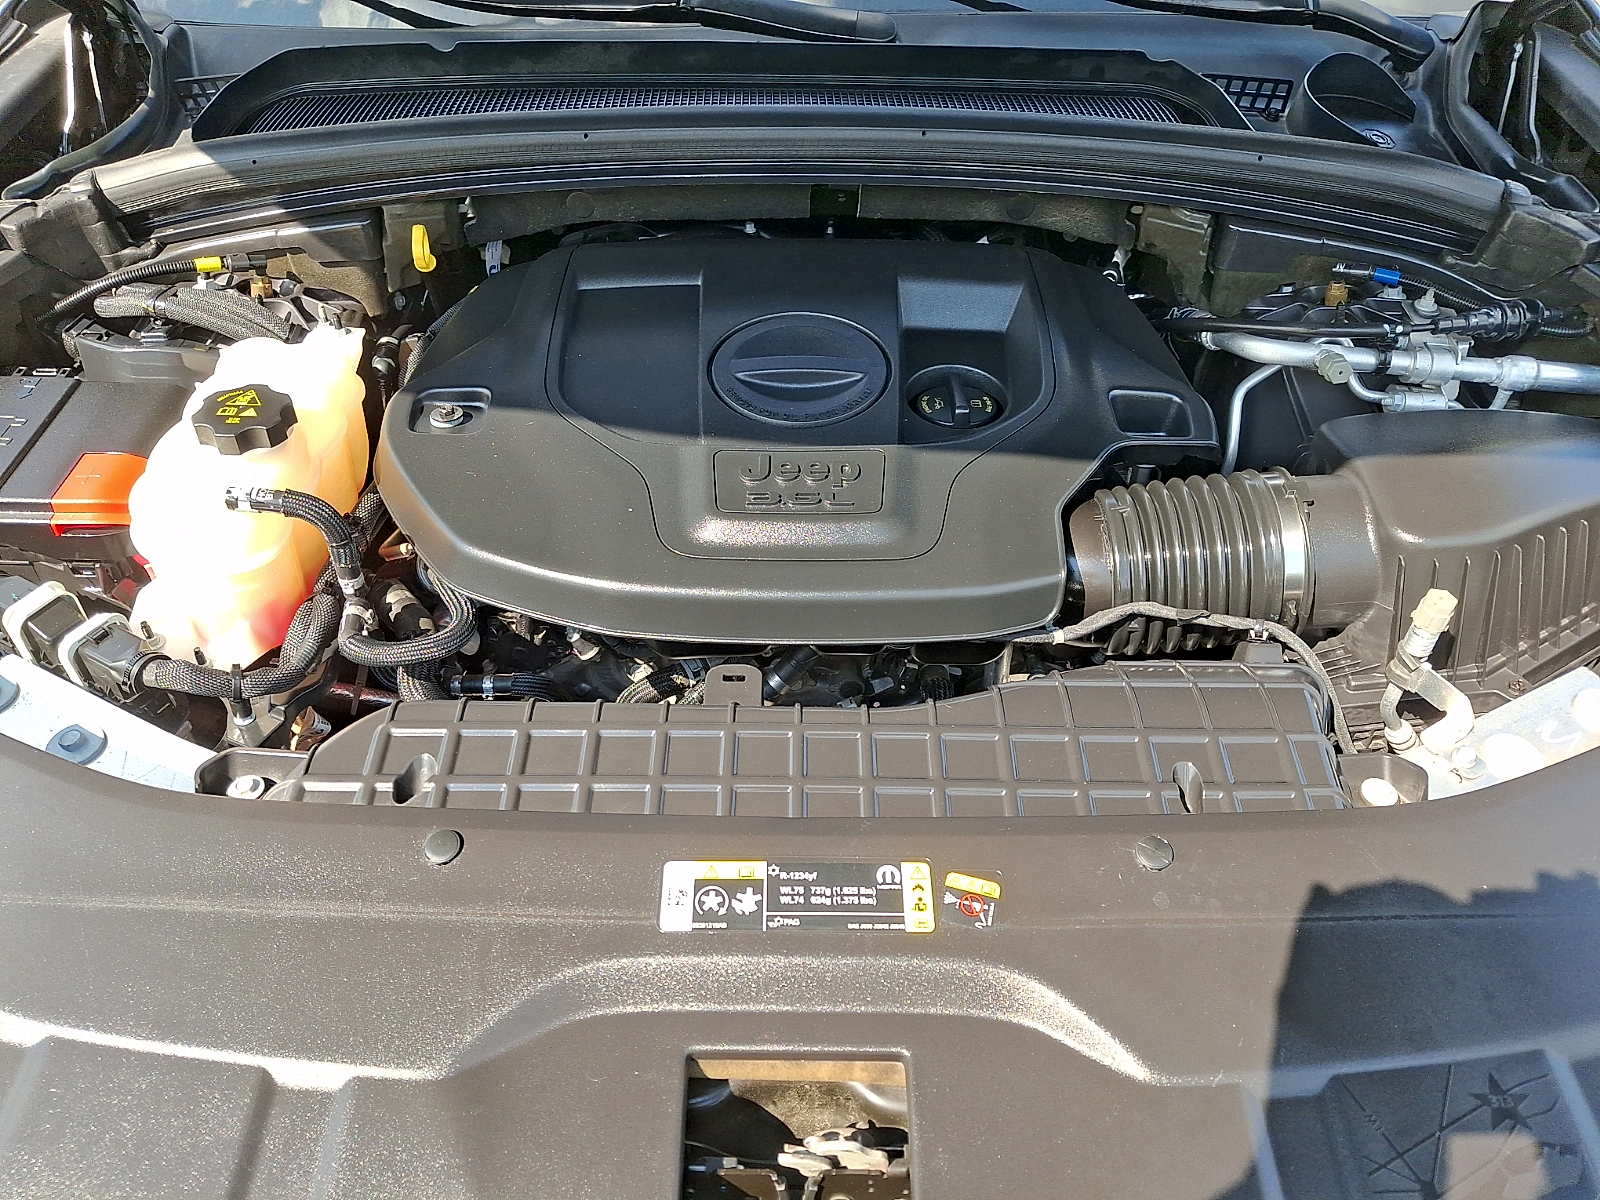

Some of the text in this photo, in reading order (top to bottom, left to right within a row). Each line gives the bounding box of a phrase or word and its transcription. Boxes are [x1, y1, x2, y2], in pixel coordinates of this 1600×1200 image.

[739, 454, 862, 488] Jeep
[745, 491, 855, 507] 3.6L
[779, 871, 818, 881] R-1234yf
